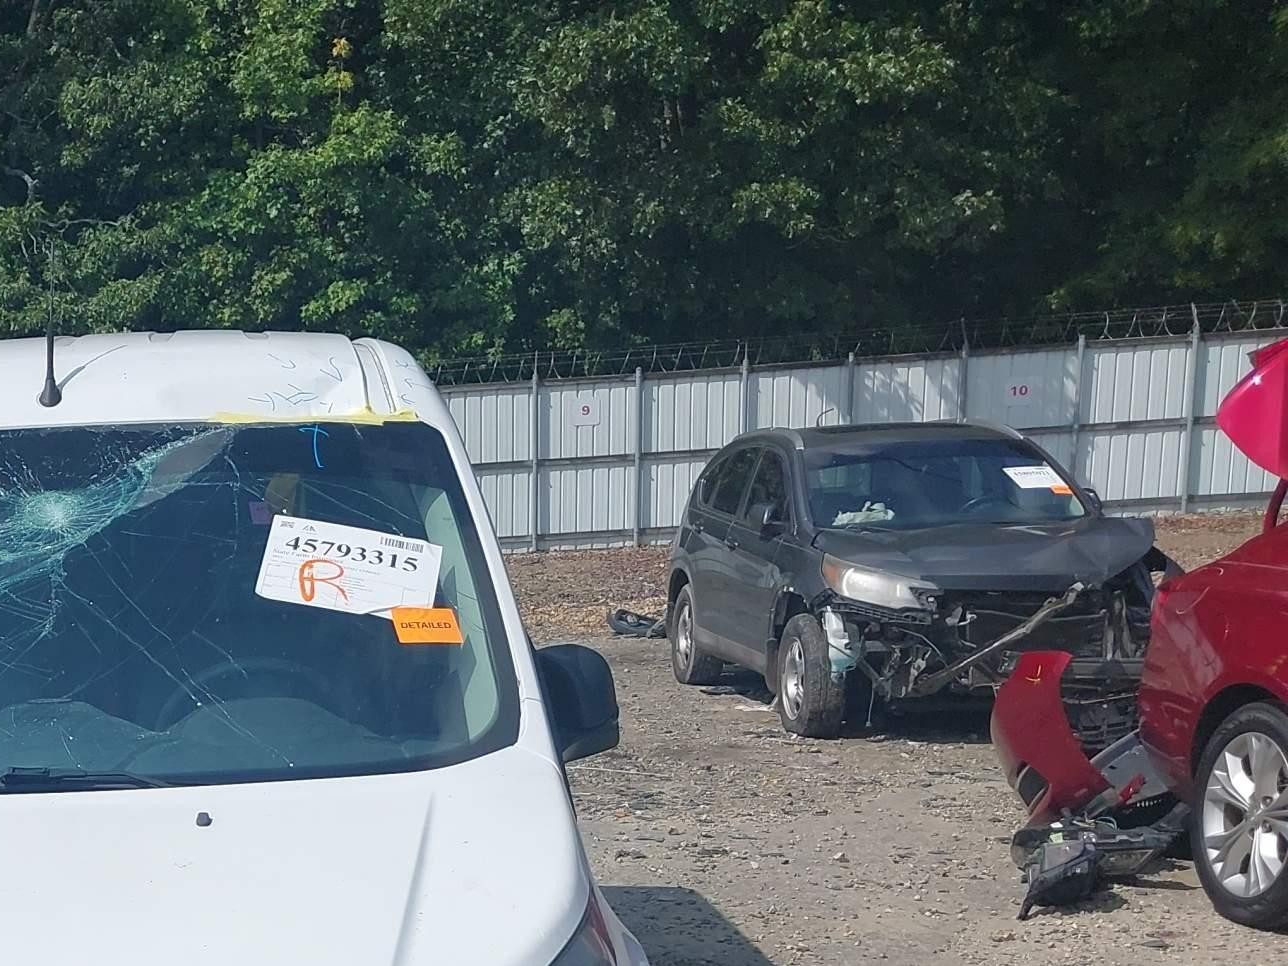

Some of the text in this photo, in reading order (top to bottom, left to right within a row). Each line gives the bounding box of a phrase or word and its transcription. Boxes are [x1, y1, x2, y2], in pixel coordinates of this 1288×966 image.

[1010, 384, 1028, 396] 10
[581, 405, 590, 416] 9
[285, 535, 419, 573] 45793315
[297, 558, 350, 606] R
[400, 621, 452, 630] DETAILED
